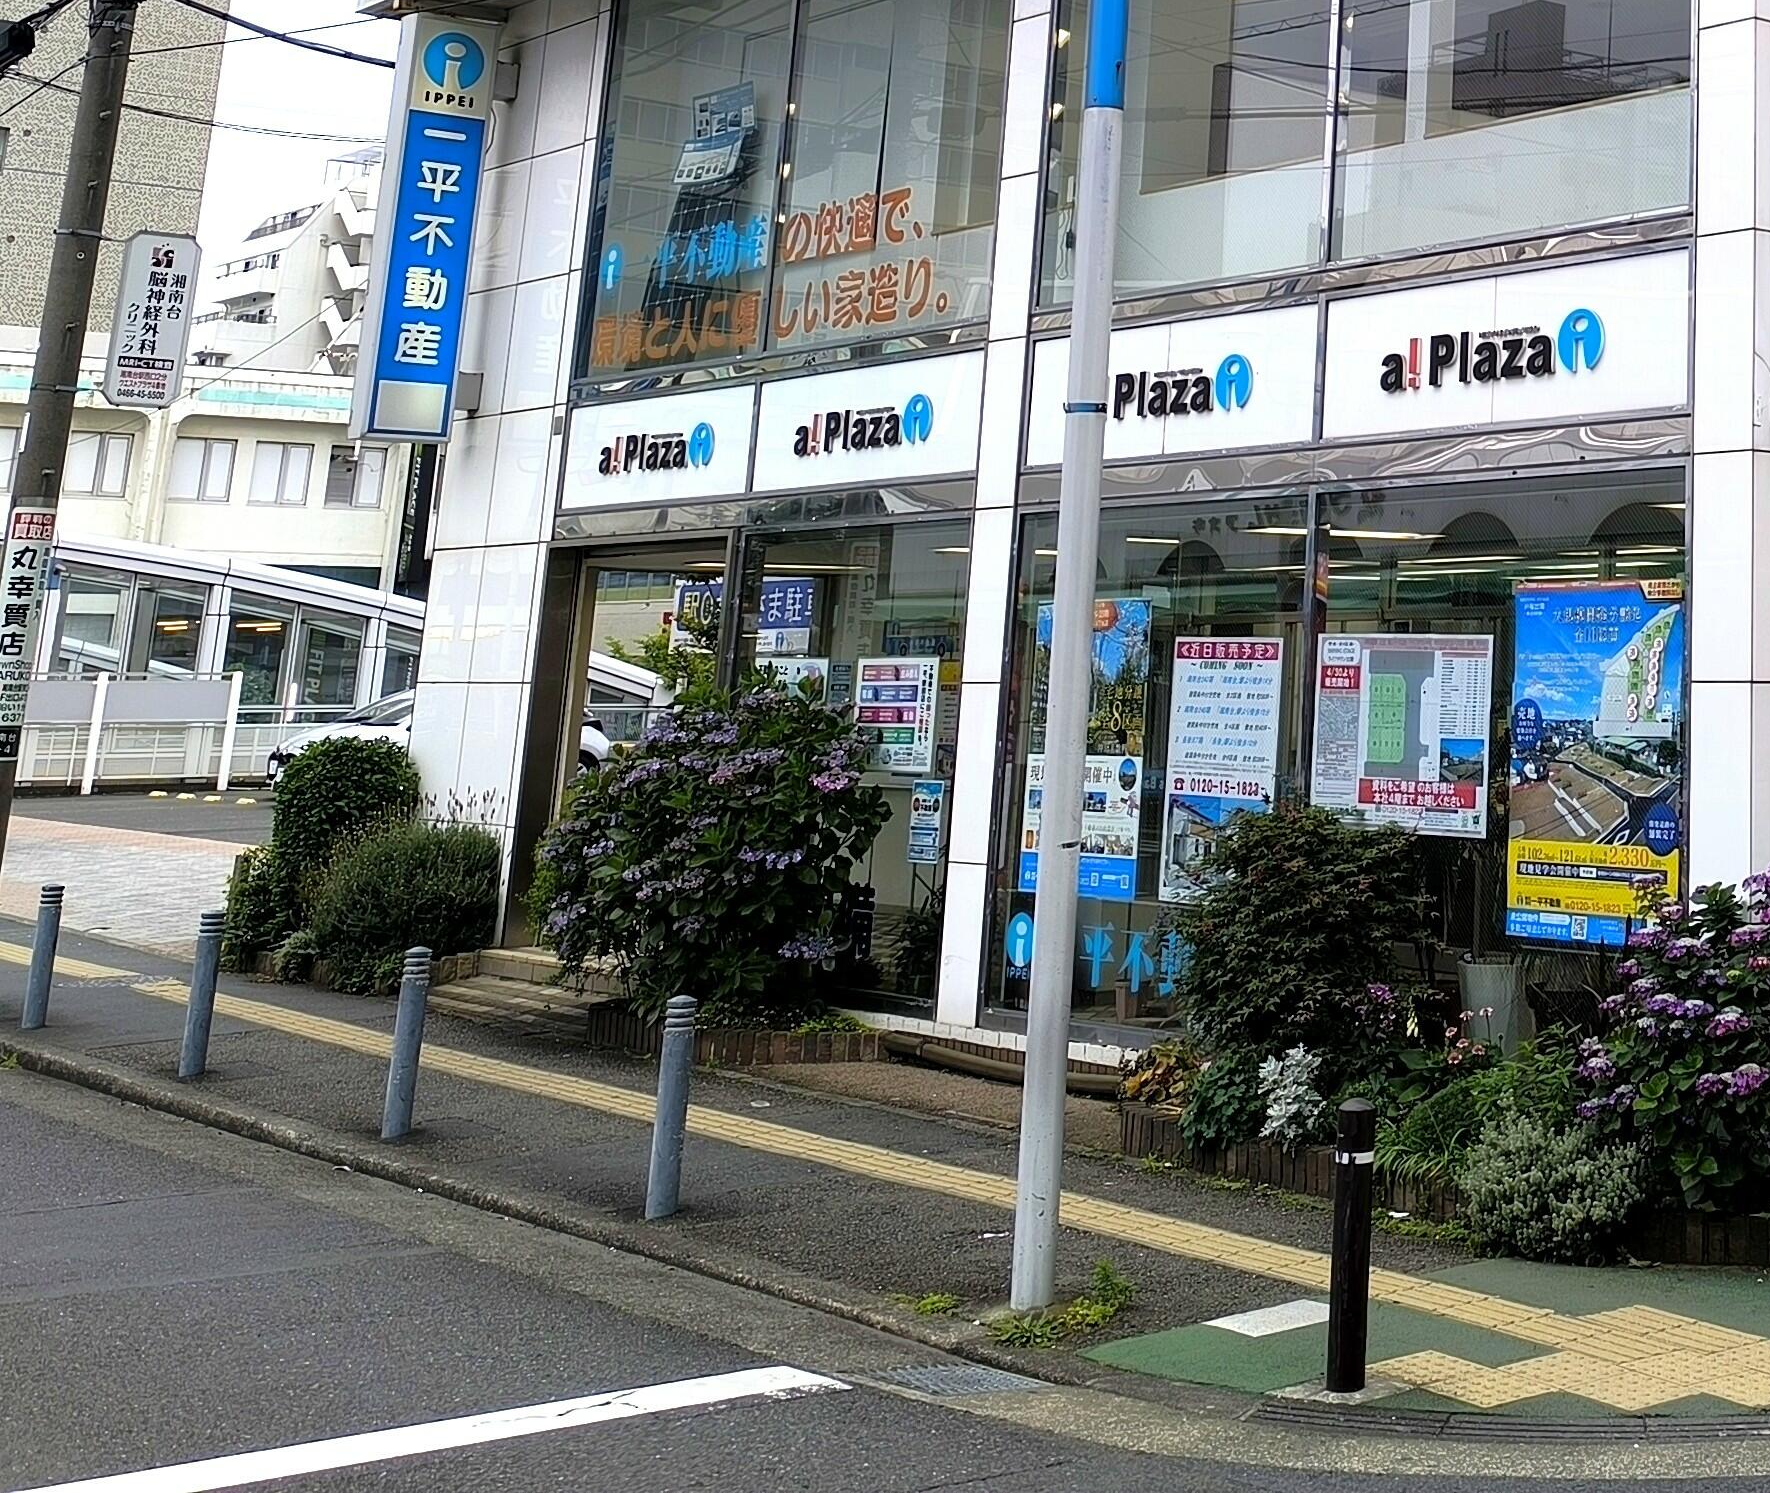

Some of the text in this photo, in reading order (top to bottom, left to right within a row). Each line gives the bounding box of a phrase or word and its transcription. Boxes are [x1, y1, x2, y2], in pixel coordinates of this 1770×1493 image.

[424, 90, 475, 108] IPPEI
[394, 127, 467, 365] 一平不動産
[137, 271, 168, 356] 脳神経外科
[166, 274, 187, 320] 湘南台
[121, 302, 140, 353] クリニック
[1113, 370, 1214, 420] Plaza
[14, 523, 52, 540] 買取店
[1, 545, 38, 656] 丸幸質店
[0, 671, 31, 682] ARUKO
[308, 649, 324, 675] FIT
[1199, 660, 1254, 670] COMING SOON
[1190, 778, 1260, 796] 0120-15-1823
